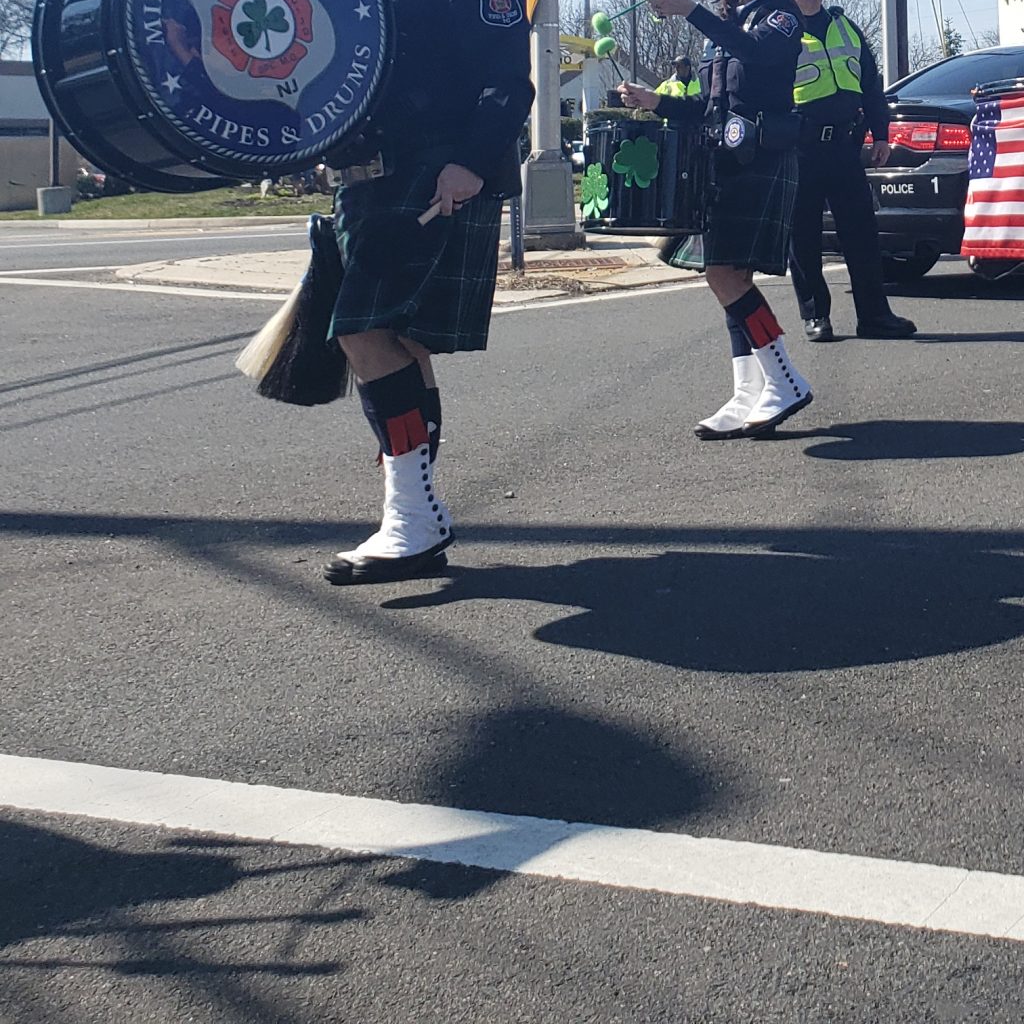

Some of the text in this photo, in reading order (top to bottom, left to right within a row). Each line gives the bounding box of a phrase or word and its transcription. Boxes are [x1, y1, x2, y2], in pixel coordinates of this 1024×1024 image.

[195, 104, 270, 148] PIPES
[280, 126, 302, 145] &
[305, 43, 372, 136] DRUMS
[276, 77, 300, 99] NJ
[881, 176, 939, 194] POLICE 1
